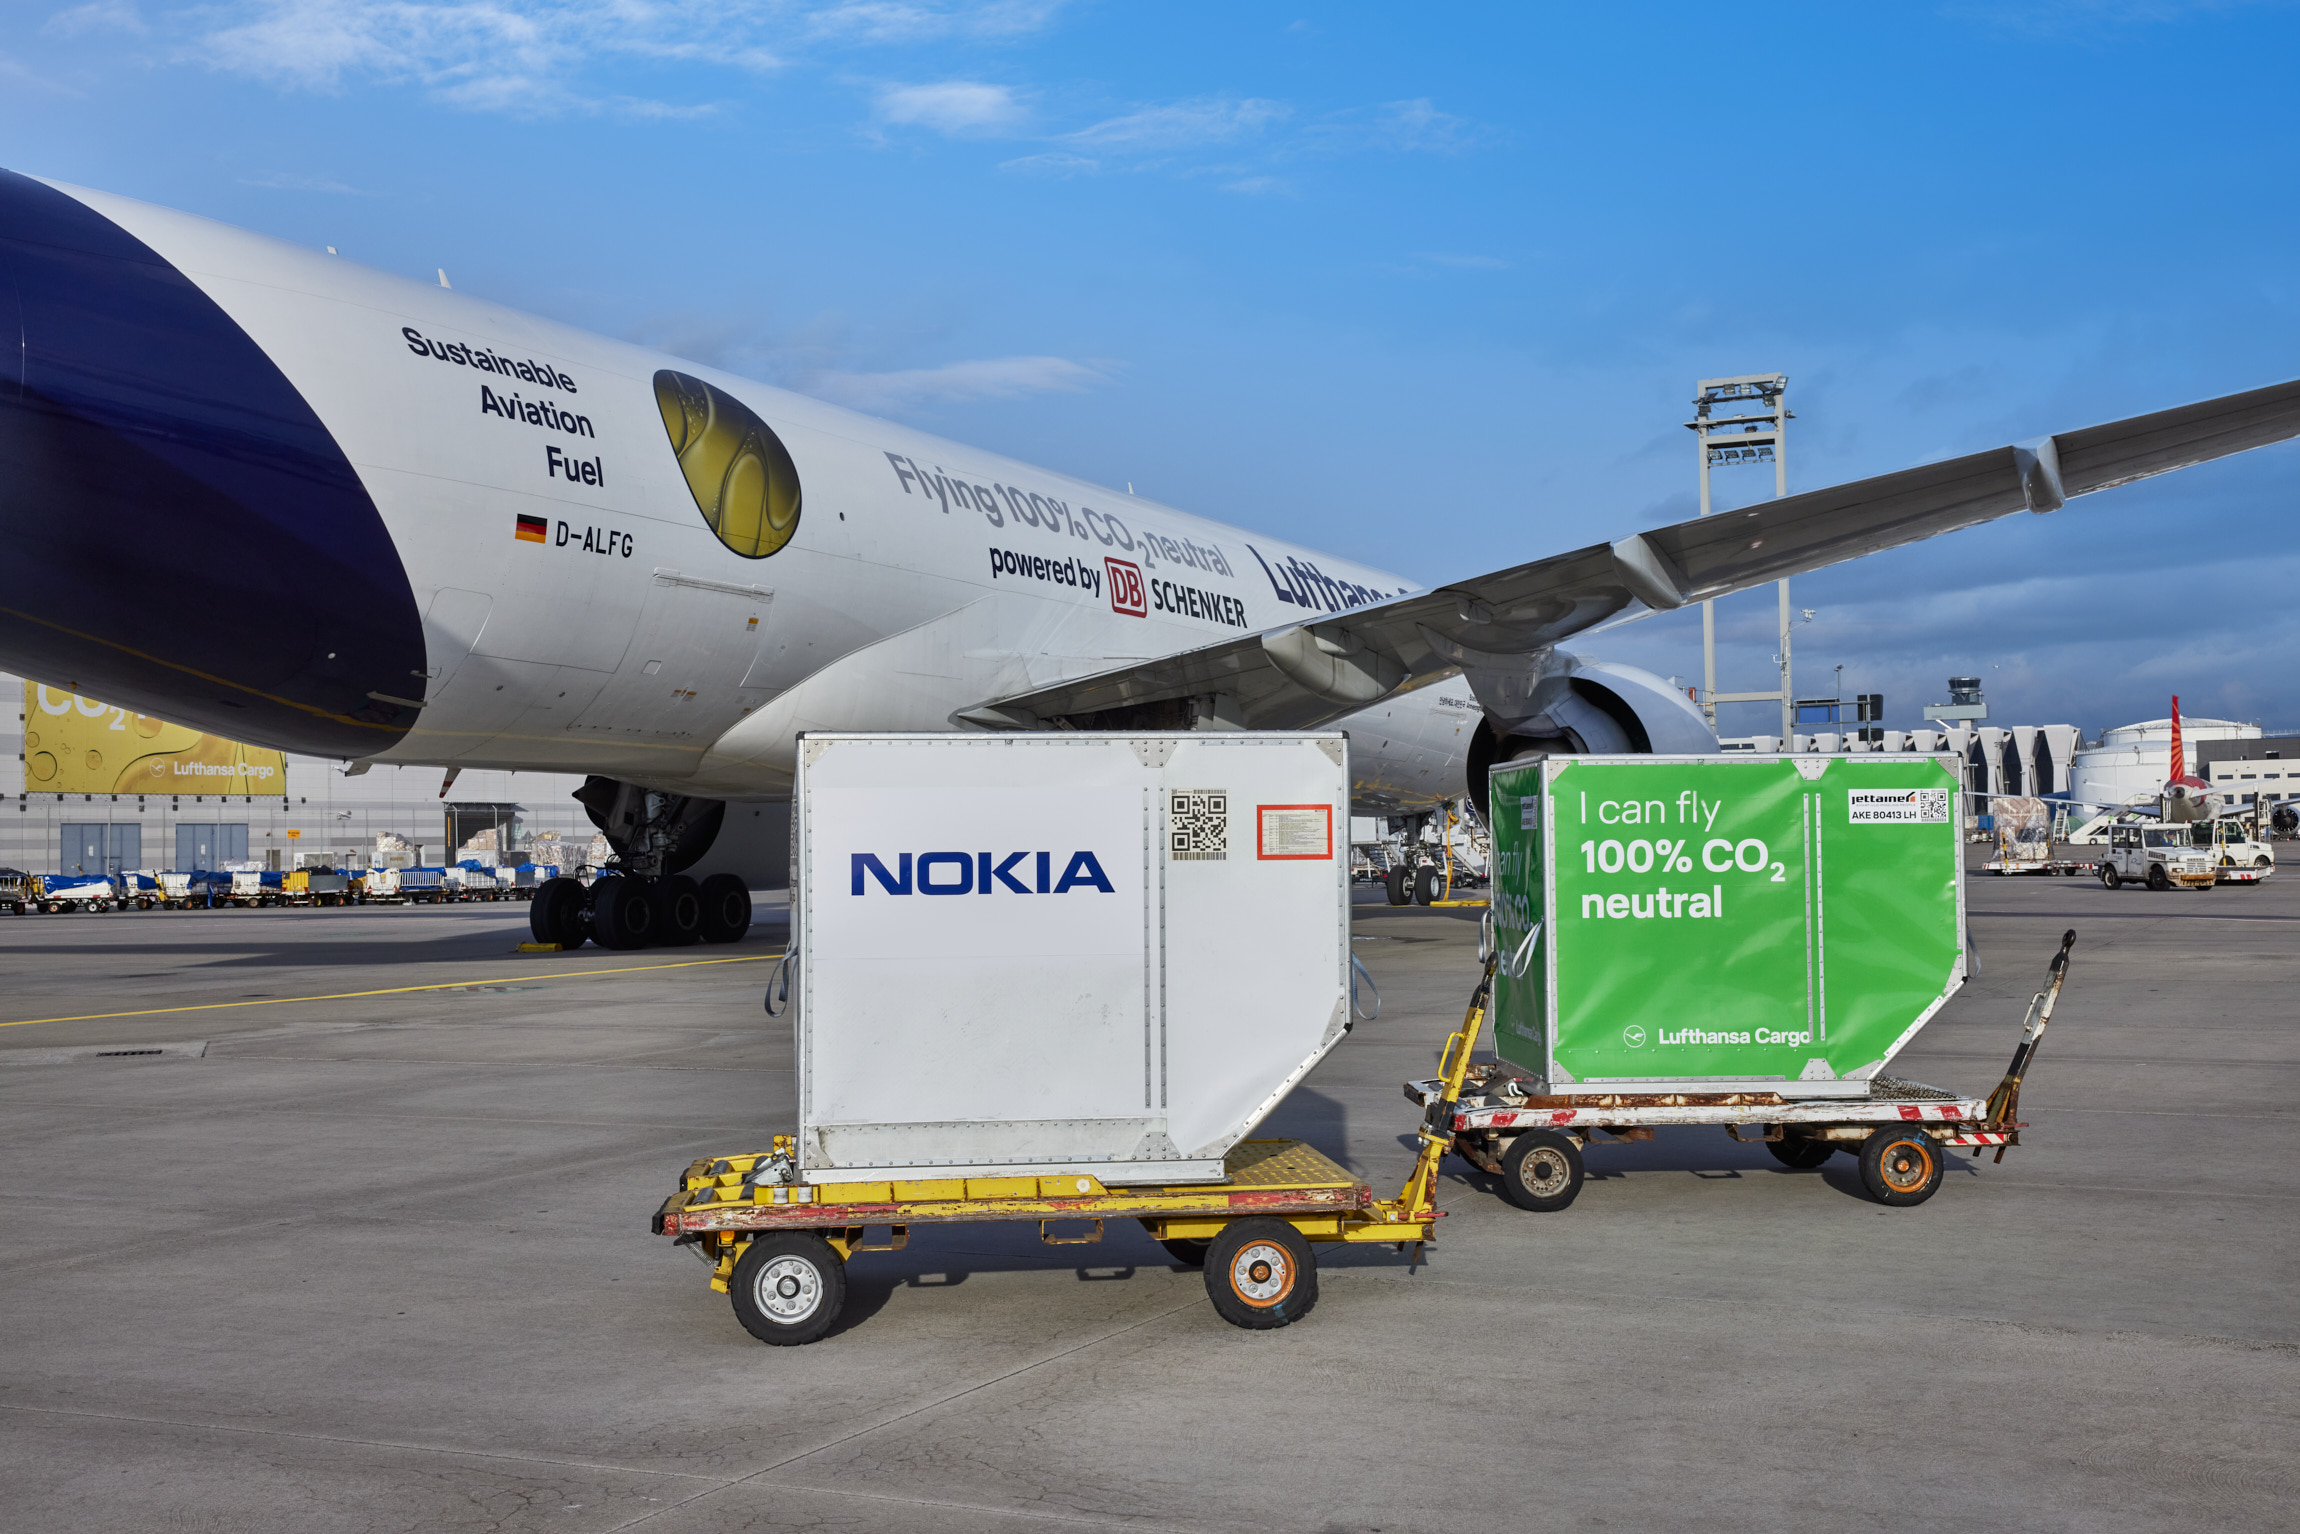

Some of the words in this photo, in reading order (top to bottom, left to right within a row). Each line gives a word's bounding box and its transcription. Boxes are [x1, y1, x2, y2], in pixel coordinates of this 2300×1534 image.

[401, 327, 577, 393] Sustainable
[481, 384, 595, 438] Aviation
[546, 445, 604, 487] Fuel
[883, 451, 1004, 528] Flying
[994, 483, 1089, 540] 100%
[1142, 531, 1234, 578] neutral
[556, 520, 633, 558] D-ALFG
[989, 547, 1077, 586] powered
[1077, 558, 1100, 598] by
[1109, 564, 1144, 610] DB
[1151, 578, 1248, 628] SCHENKER
[174, 761, 235, 776] Lufthansa
[238, 762, 274, 779] Cargo
[1580, 791, 1586, 824] I
[1598, 799, 1666, 824] can
[1676, 790, 1721, 832] fly
[1852, 791, 1914, 804] jettainer
[1852, 811, 1871, 819] AKE
[1873, 811, 1902, 819] 80413
[1904, 811, 1916, 819] LH
[851, 851, 1115, 896] NOKIA
[1581, 839, 1693, 874] 100%
[1581, 884, 1722, 919] neutral
[1658, 1028, 1751, 1045] Lufthansa
[1755, 1028, 1811, 1049] Cargo
